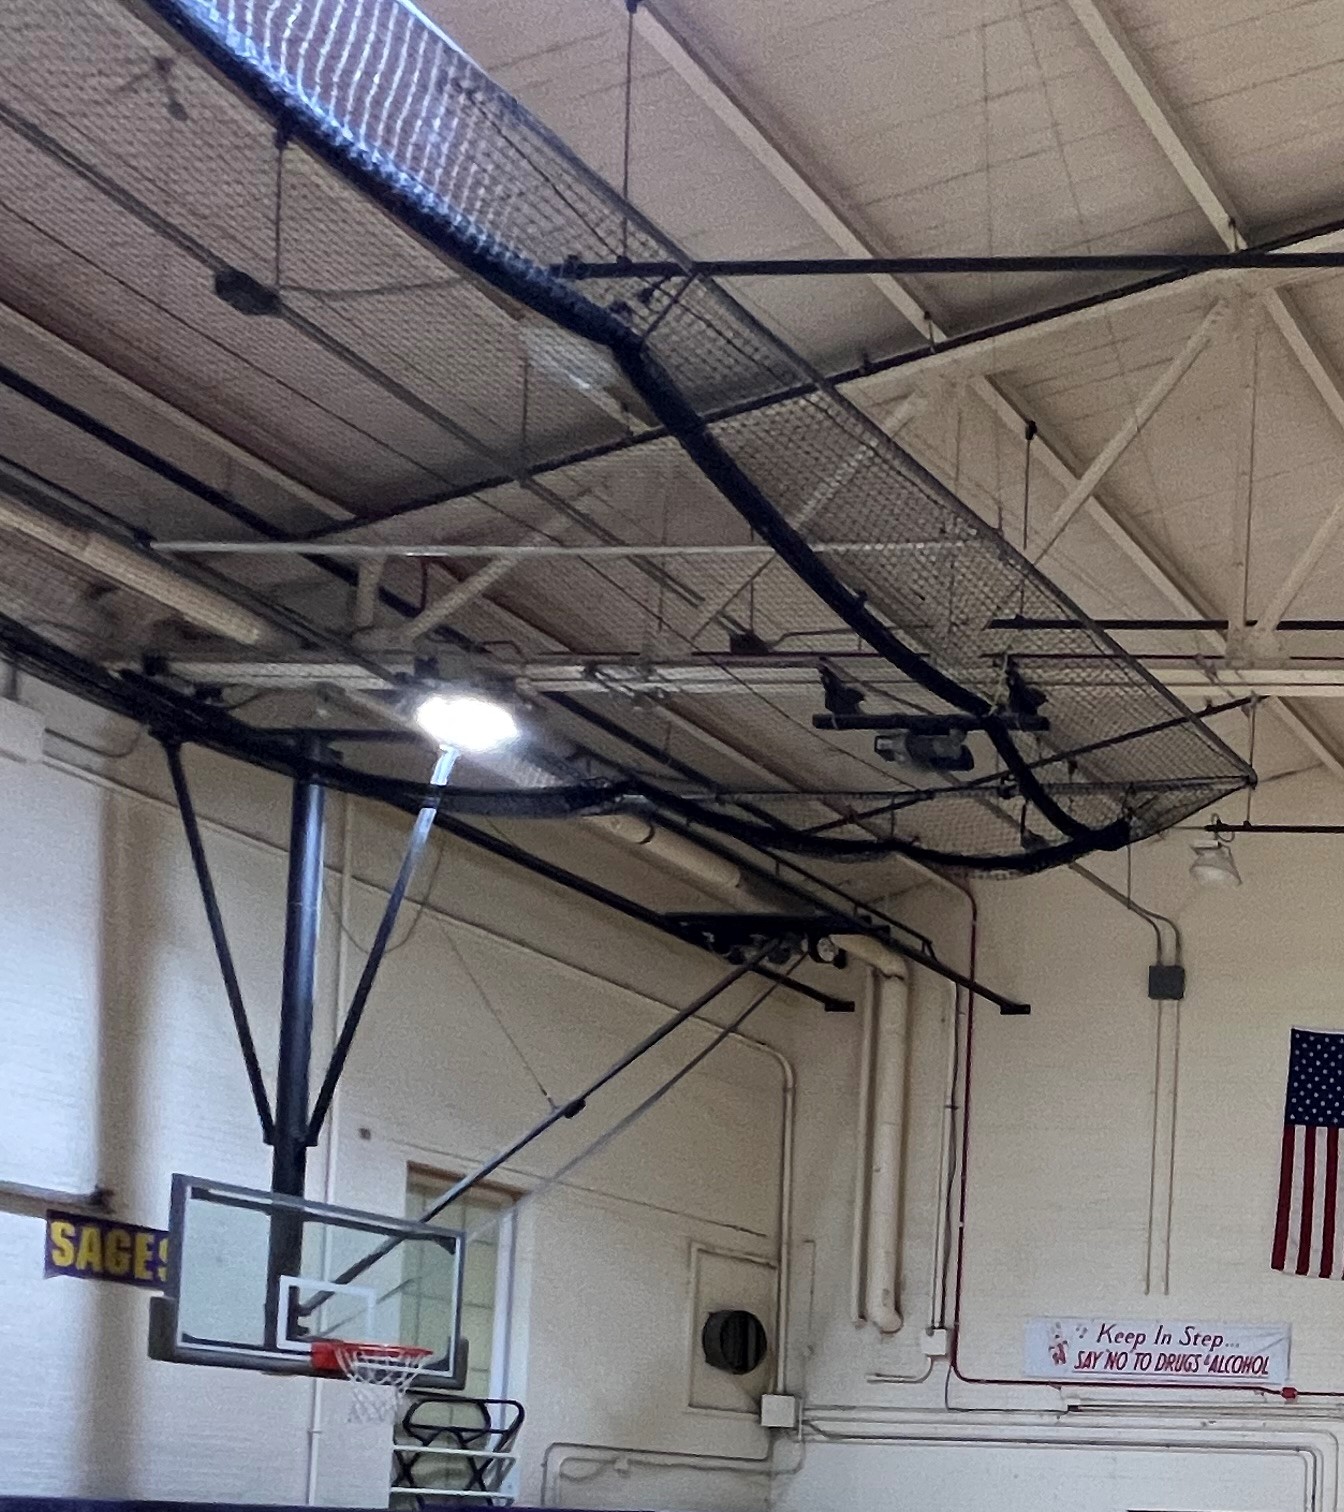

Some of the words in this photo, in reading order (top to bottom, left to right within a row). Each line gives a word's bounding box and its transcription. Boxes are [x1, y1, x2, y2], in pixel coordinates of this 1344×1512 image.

[1096, 1322, 1147, 1352] Keep
[1153, 1324, 1173, 1346] In
[1073, 1350, 1105, 1370] SAY
[1103, 1350, 1129, 1371] NO
[1132, 1351, 1153, 1372] TO
[1153, 1352, 1203, 1373] DRUGS
[1207, 1354, 1270, 1375] ALCOHOL
